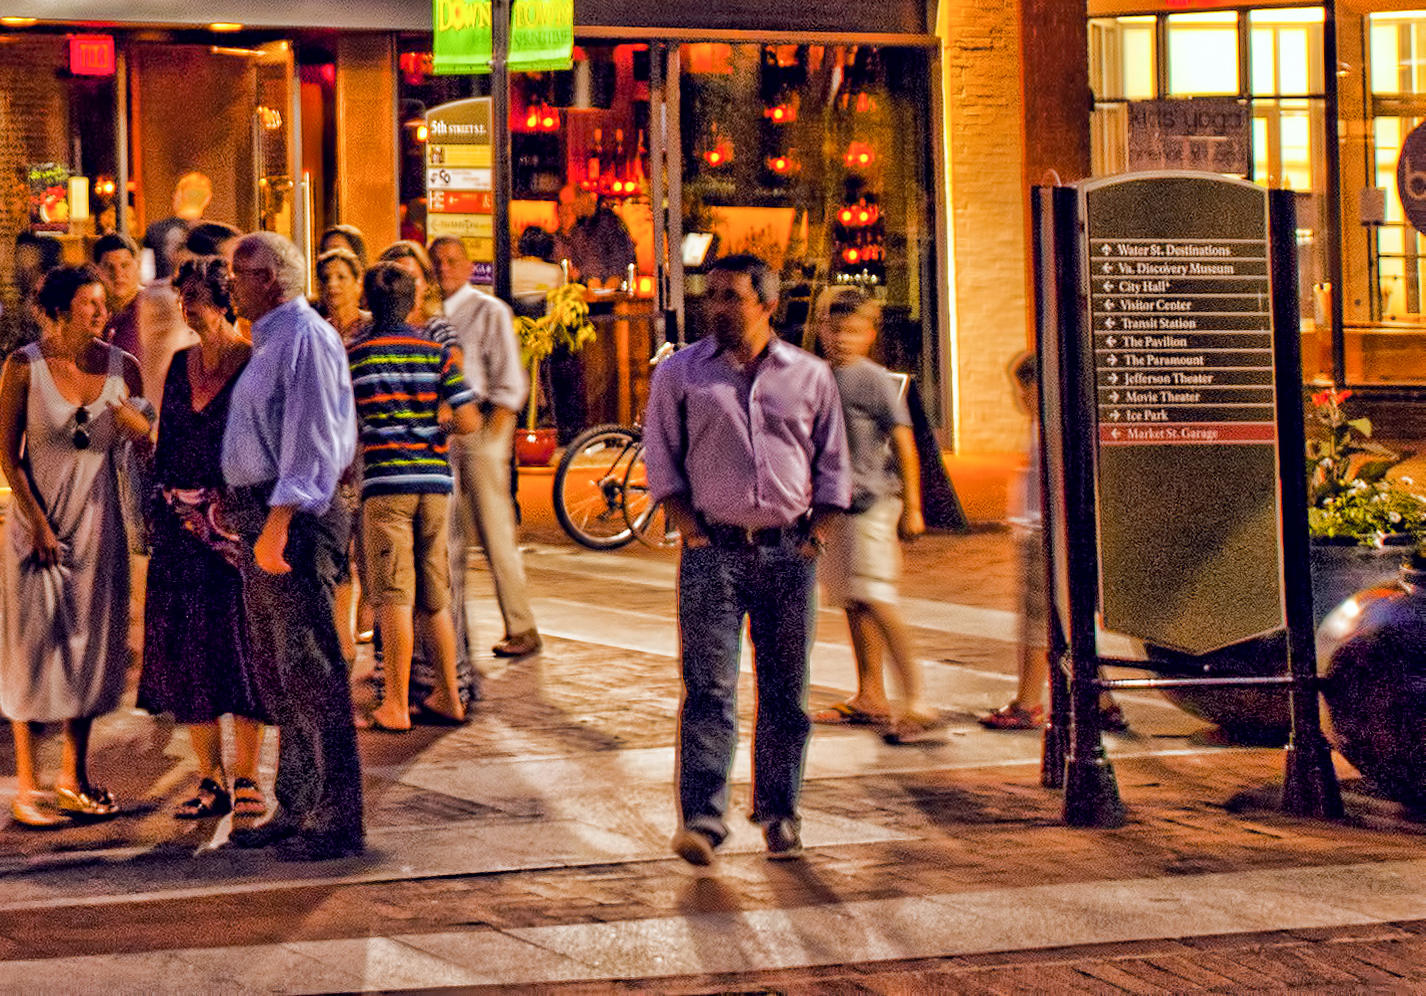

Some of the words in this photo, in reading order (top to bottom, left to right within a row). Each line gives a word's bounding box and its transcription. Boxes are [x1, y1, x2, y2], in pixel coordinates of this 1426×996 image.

[515, 0, 572, 28] TOWN
[431, 119, 447, 134] 5th
[449, 124, 473, 134] STREET
[1117, 244, 1148, 256] Water
[1150, 244, 1164, 256] St.
[1166, 244, 1232, 256] Destinations
[1119, 262, 1135, 275] Va.
[1137, 262, 1188, 276] Discovery
[1190, 262, 1234, 275] Museum
[1118, 280, 1142, 294] City
[1120, 299, 1154, 311] Visitor
[1156, 299, 1192, 311] Center
[1122, 317, 1158, 329] Transit
[1160, 317, 1196, 329] Station
[1123, 335, 1143, 347] The
[1145, 335, 1187, 347] Pavilion
[1125, 354, 1145, 366] The
[1147, 354, 1204, 366] Paramount
[1125, 372, 1171, 385] Jefferson
[1173, 372, 1214, 384] Theater
[1126, 390, 1158, 402] Movie
[1161, 390, 1201, 402] Theater
[1126, 409, 1142, 421] Ice
[1144, 409, 1168, 421] Park
[1127, 428, 1165, 440] Market
[1166, 428, 1180, 439] St.
[1181, 428, 1219, 442] Garage
